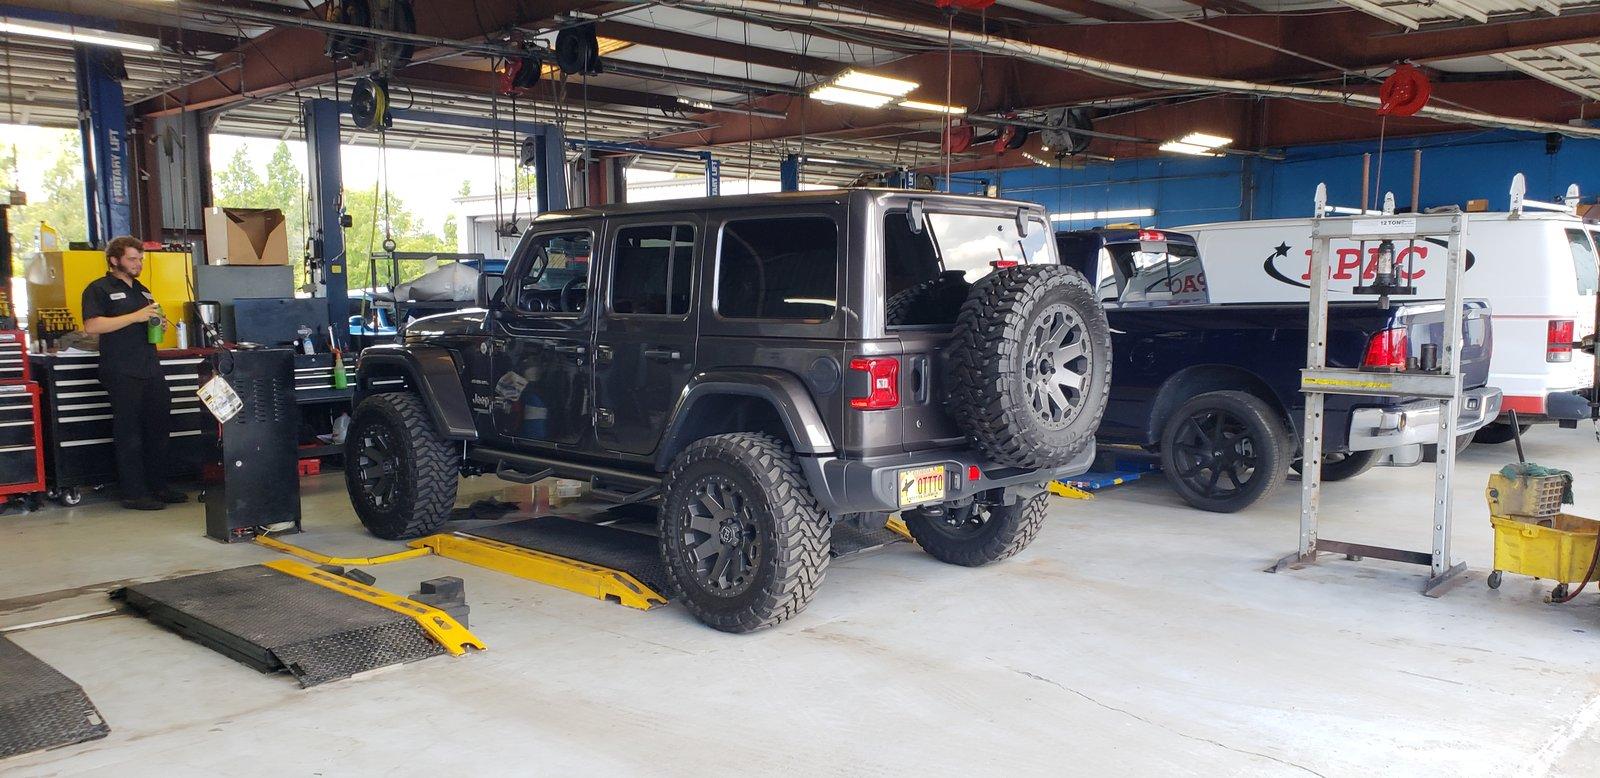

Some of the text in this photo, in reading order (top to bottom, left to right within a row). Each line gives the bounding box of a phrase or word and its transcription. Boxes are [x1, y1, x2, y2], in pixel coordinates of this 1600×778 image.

[108, 128, 122, 197] ROTARY LIFT
[472, 393, 490, 408] Jeep
